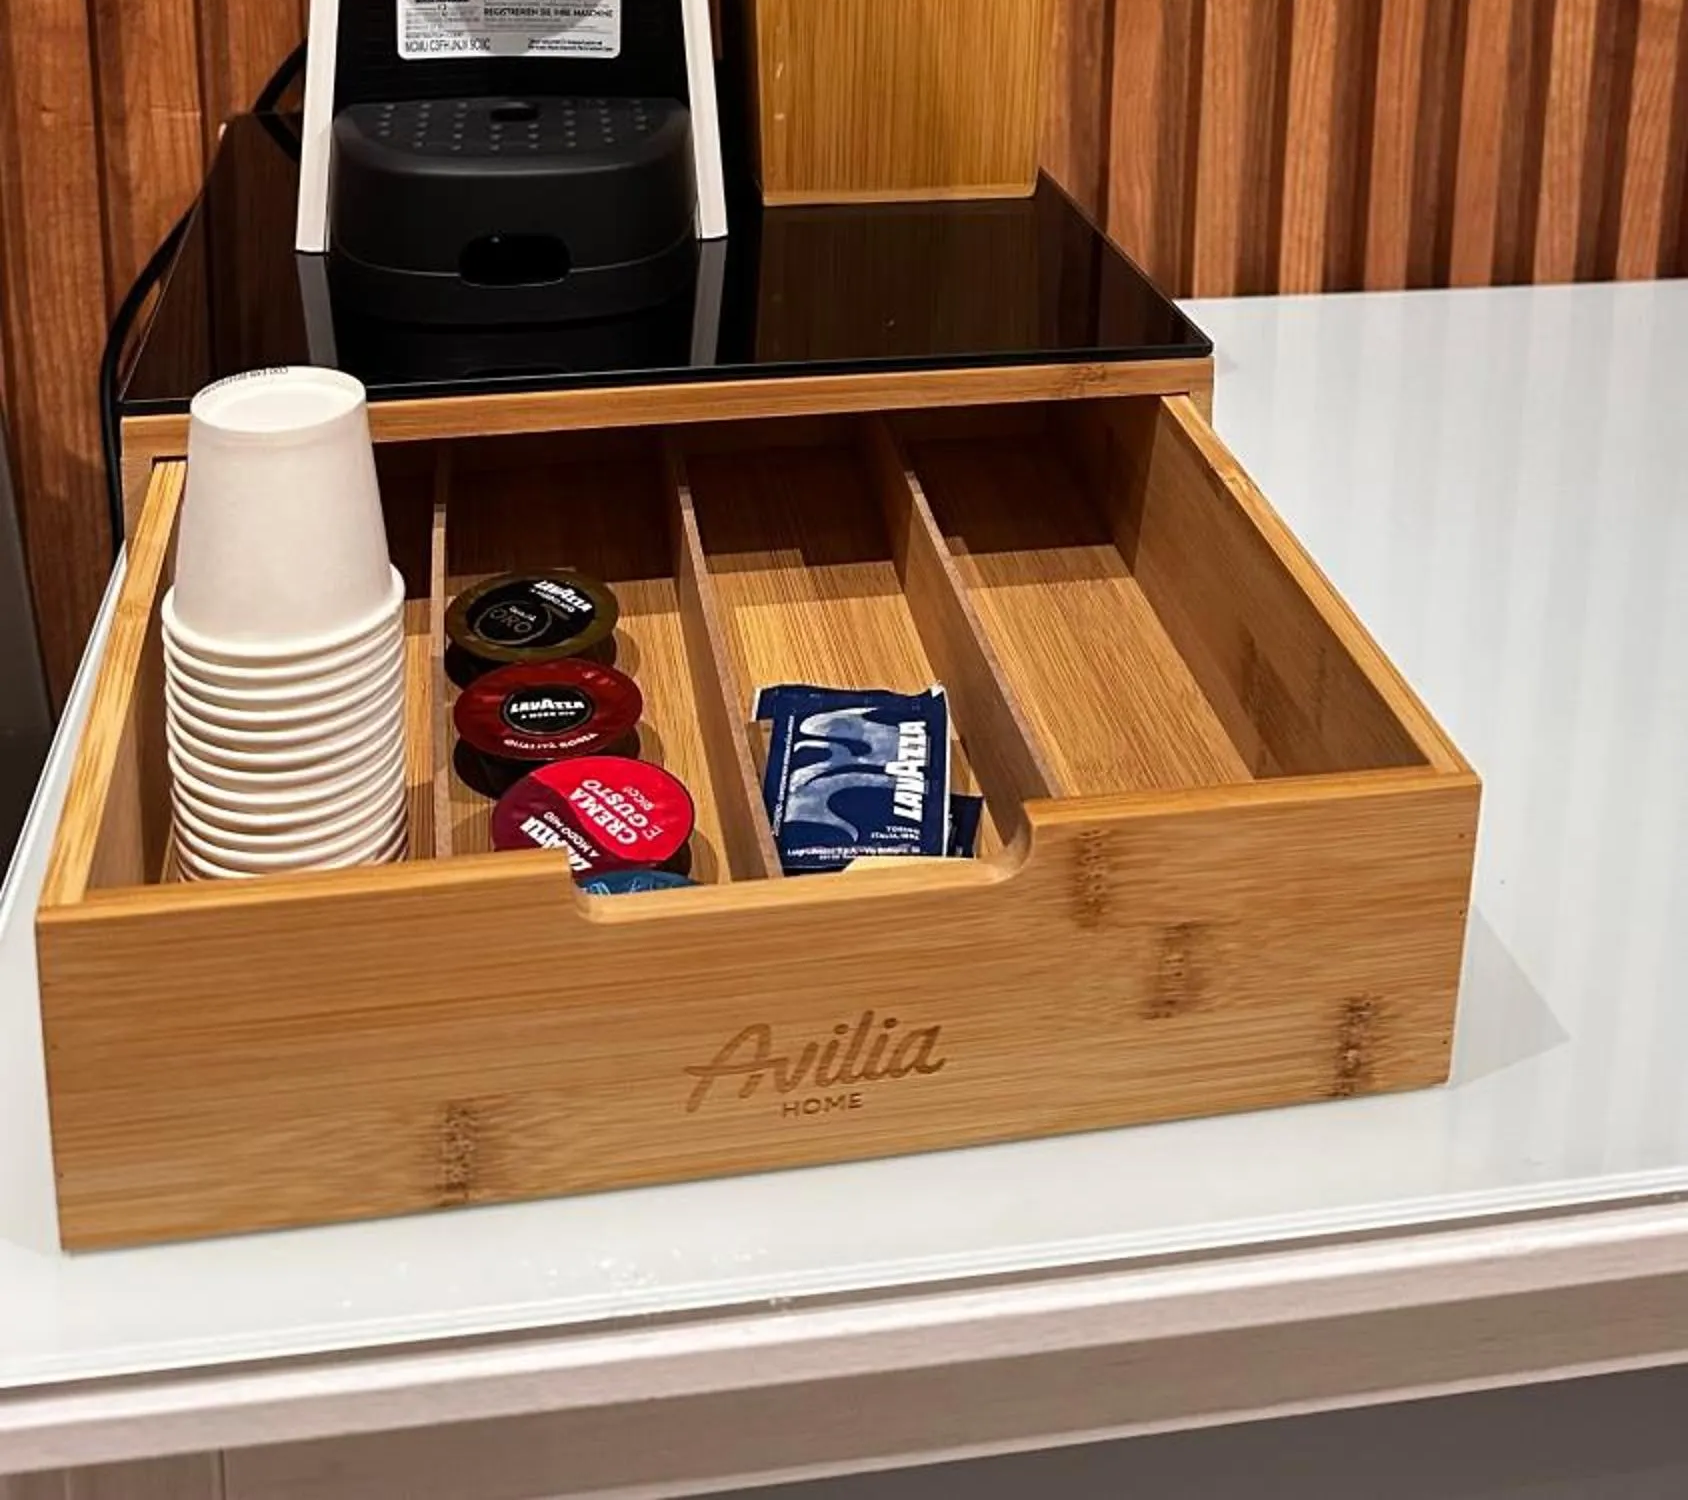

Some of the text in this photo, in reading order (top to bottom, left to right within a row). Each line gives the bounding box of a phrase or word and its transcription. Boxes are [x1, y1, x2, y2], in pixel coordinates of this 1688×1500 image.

[533, 580, 593, 612] LAVAZZA
[489, 608, 533, 634] ORO
[510, 698, 586, 714] LAVAZZA
[884, 720, 928, 823] LAVAZZA
[568, 787, 638, 845] CREMA
[581, 778, 649, 828] GUSTO
[683, 1010, 947, 1113] Avilia
[782, 1092, 863, 1118] HOME
